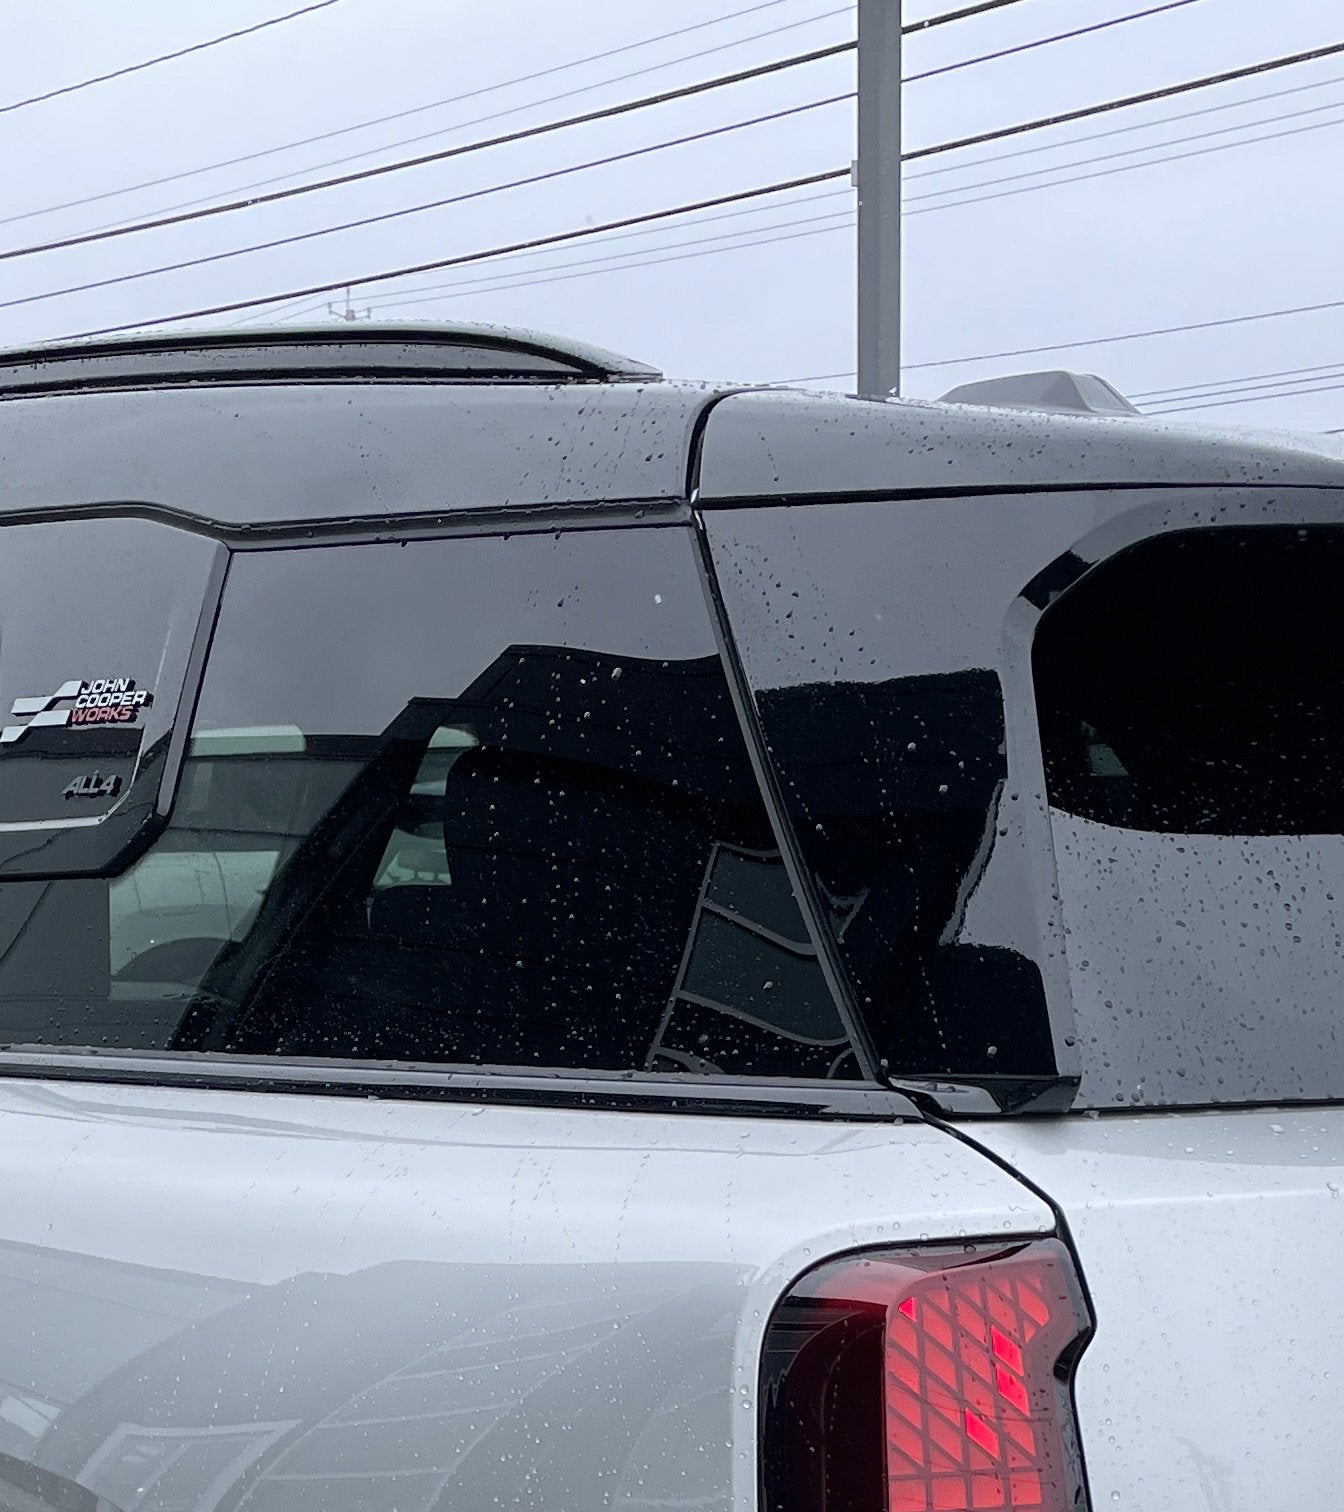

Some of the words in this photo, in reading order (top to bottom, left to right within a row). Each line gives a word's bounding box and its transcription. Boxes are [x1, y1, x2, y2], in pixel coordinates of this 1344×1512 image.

[81, 678, 130, 694] JOHN
[75, 690, 147, 709] COOPER
[71, 705, 134, 723] WORKS
